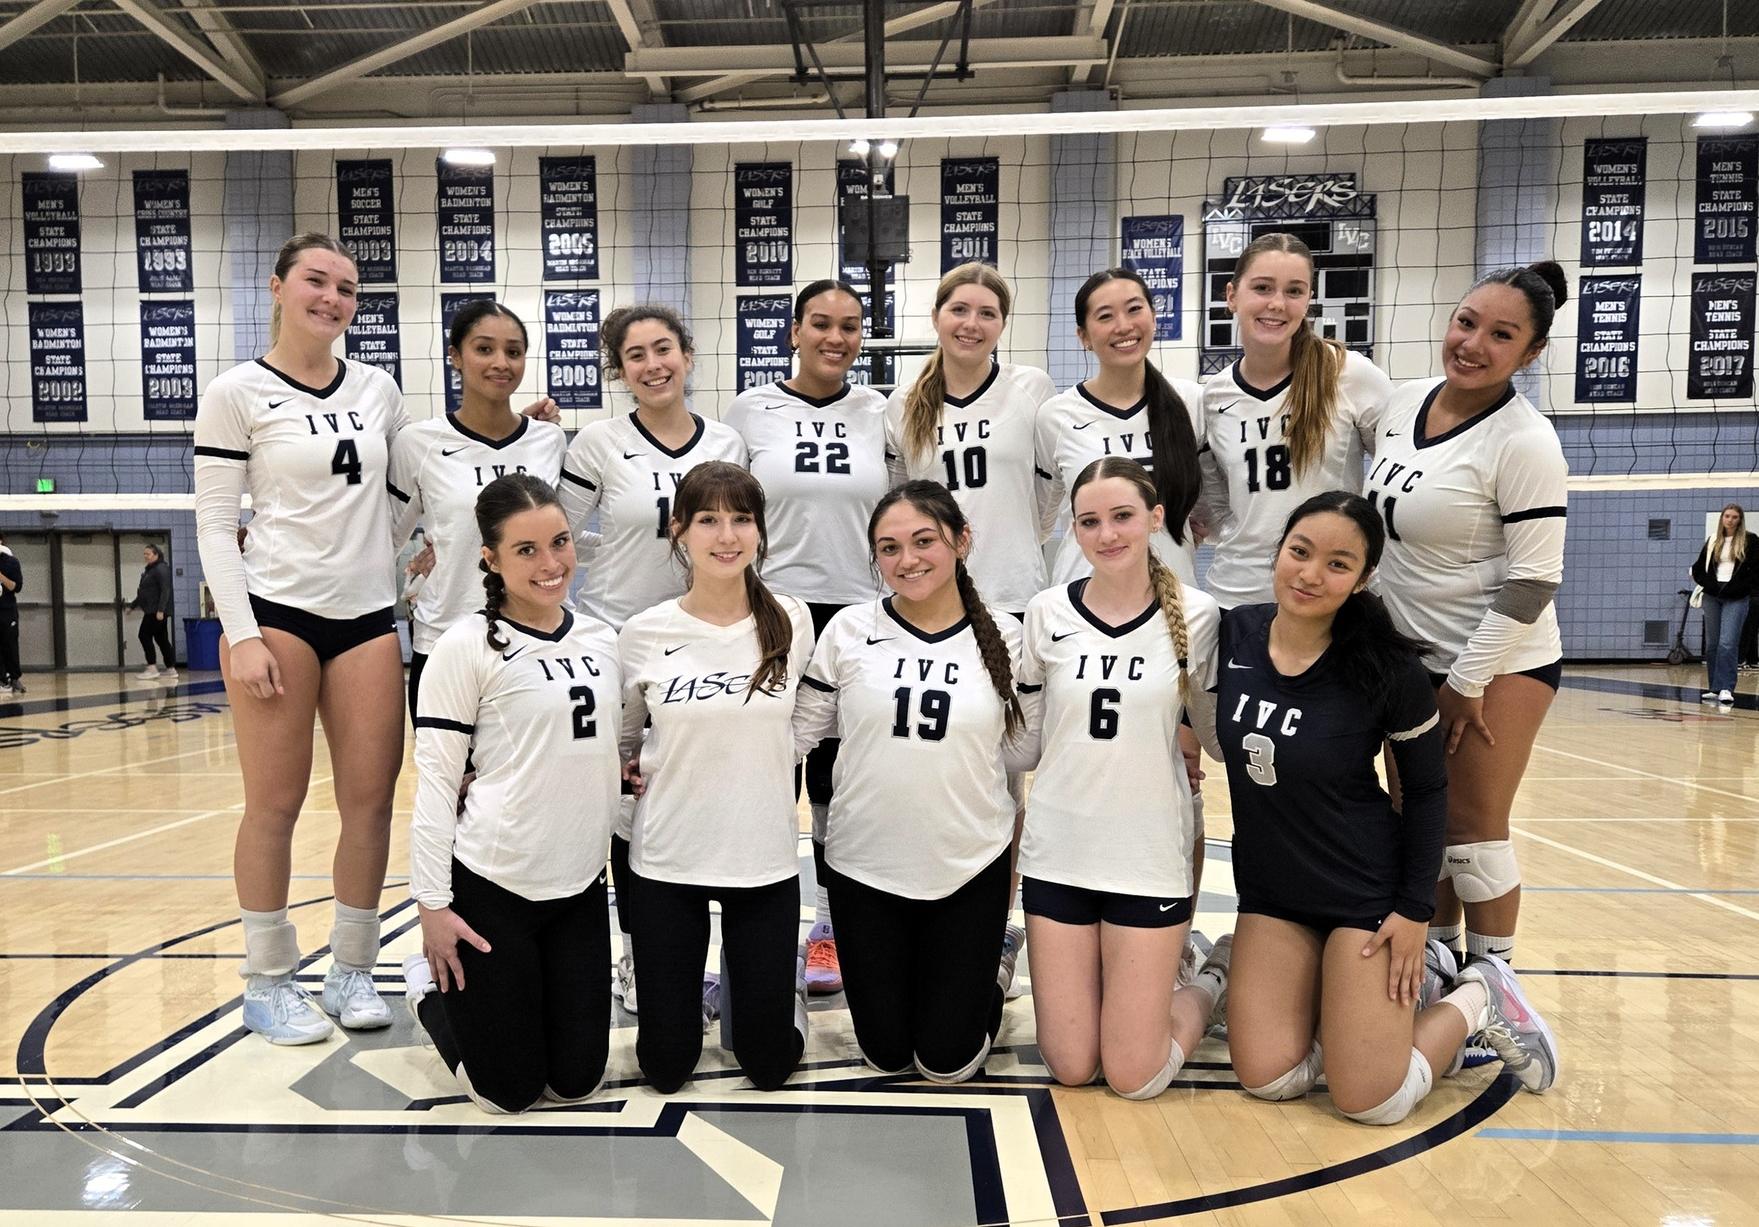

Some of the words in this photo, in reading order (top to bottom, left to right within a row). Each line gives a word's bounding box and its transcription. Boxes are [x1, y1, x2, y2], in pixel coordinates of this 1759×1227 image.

[1594, 164, 1637, 173] WOMEN'S
[1713, 162, 1742, 171] MEN'S
[1710, 174, 1743, 183] TENNIS
[446, 187, 486, 195] WOMEN'S
[549, 182, 588, 191] WOMENS
[957, 184, 984, 193] MEN'S
[744, 188, 783, 197] WOMEN'S
[1713, 191, 1741, 200] STATE
[441, 198, 491, 207] BADMINTON
[544, 194, 594, 203] BADMINTON
[945, 195, 996, 204] VOLLEYBALL
[1600, 194, 1629, 204] STATE
[351, 200, 381, 208] SOCCER
[753, 200, 773, 208] GOLF
[1699, 202, 1753, 212] CHAMPIONS
[956, 212, 982, 220] STATE
[1586, 206, 1641, 216] CHAMPIONS
[354, 215, 379, 224] STATE
[453, 214, 479, 223] STATE
[545, 218, 594, 228] CHAMPIONS
[751, 216, 776, 225] STATE
[40, 227, 64, 236] STATE
[151, 225, 176, 234] STATE
[342, 226, 391, 236] CHAMPIONS
[442, 226, 491, 235] CHAMPIONS
[739, 228, 788, 237] CHAMPIONS
[944, 223, 995, 232] CHAMPIONS
[1589, 221, 1636, 242] 2014
[1704, 217, 1748, 238] 2015
[140, 236, 187, 246] CHAMPIONS
[1212, 226, 1244, 254] IVC
[1338, 223, 1370, 249] IVC
[29, 238, 77, 248] CHAMPIONS
[549, 233, 593, 255] 2005
[951, 237, 989, 258] 2011
[444, 240, 492, 261] 2004
[746, 241, 788, 262] 2010
[1144, 248, 1181, 258] VOLLEYBALL
[1595, 302, 1625, 311] MEN'S
[1709, 300, 1738, 310] MEN'S
[358, 314, 384, 324] MEN'S
[552, 312, 592, 321] WOMENS
[1593, 313, 1627, 323] TENNIS
[1705, 312, 1741, 322] TENNIS
[547, 323, 597, 333] BADMINTON
[745, 319, 785, 328] WOMEN'S
[37, 328, 76, 337] WOMEN'S
[348, 325, 397, 334] VOLLEYBALL
[754, 330, 776, 339] GOLF
[1709, 329, 1737, 339] STATE
[1594, 331, 1623, 340] STATE
[32, 339, 81, 349] BADMINTON
[144, 338, 193, 348] BADMINTON
[360, 341, 386, 350] STATE
[561, 339, 587, 348] STATE
[1581, 342, 1635, 352] CHAMPIONS
[1694, 341, 1749, 351] CHAMPIONS
[549, 350, 598, 360] CHAMPIONS
[751, 346, 778, 354] STATE
[46, 355, 71, 364] STATE
[156, 354, 182, 363] STATE
[740, 358, 789, 366] CHAMPIONS
[34, 367, 83, 375] CHAMPIONS
[145, 365, 193, 374] CHAMPIONS
[1585, 357, 1630, 378] 2016
[1700, 356, 1744, 376] 2017
[551, 365, 597, 386] 2009
[39, 381, 82, 401] 2002
[149, 378, 192, 398] 2003
[305, 411, 364, 435] IVC
[796, 421, 847, 438] IVC
[938, 419, 990, 445] IVC
[332, 439, 363, 486] 4
[794, 441, 851, 475] 22
[943, 446, 987, 491] 10
[1245, 445, 1291, 493] 18
[1370, 458, 1423, 493] IVC
[537, 656, 600, 681] IVC
[894, 658, 959, 685] IVC
[1076, 655, 1145, 680] IVC
[570, 685, 598, 739] 2
[891, 686, 951, 742] 19
[1089, 687, 1121, 741] 6
[1232, 693, 1304, 737] IVC
[1241, 732, 1278, 787] 3
